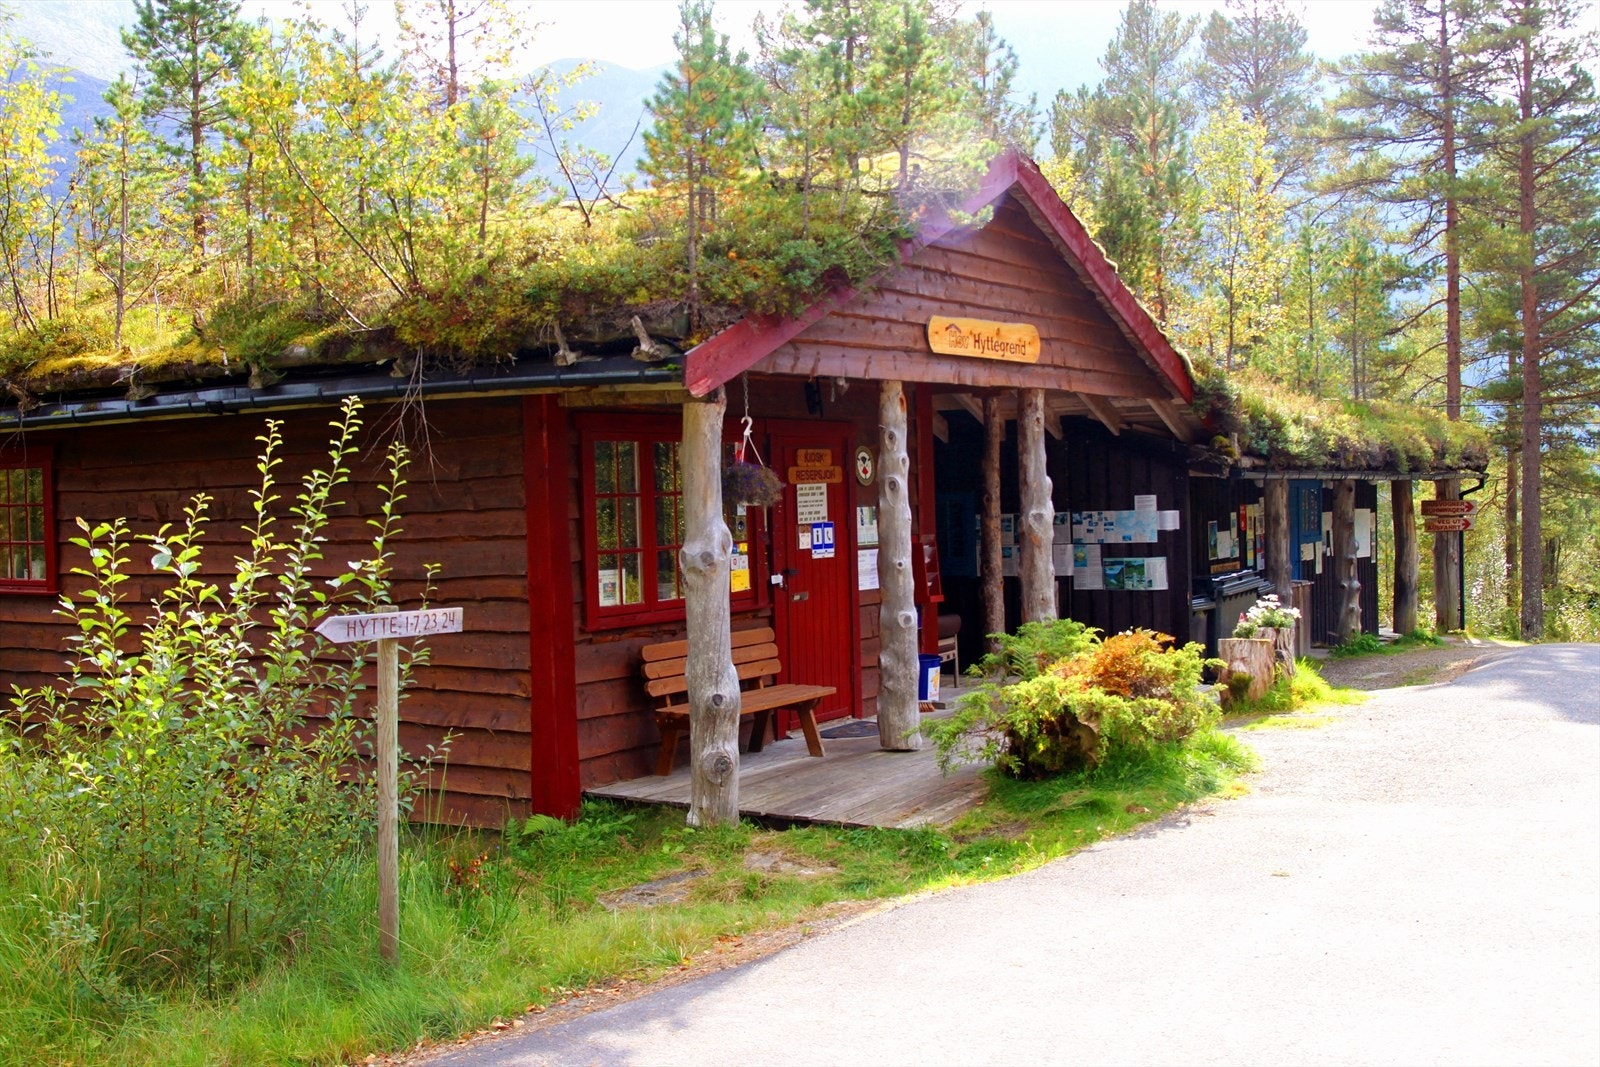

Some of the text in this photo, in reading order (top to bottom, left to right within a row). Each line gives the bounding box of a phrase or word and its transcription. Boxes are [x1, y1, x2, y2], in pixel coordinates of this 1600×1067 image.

[973, 332, 1027, 357] Hyttegrend
[803, 452, 825, 463] KIOSK
[795, 469, 836, 481] RESEPSJON
[441, 612, 455, 629] 24
